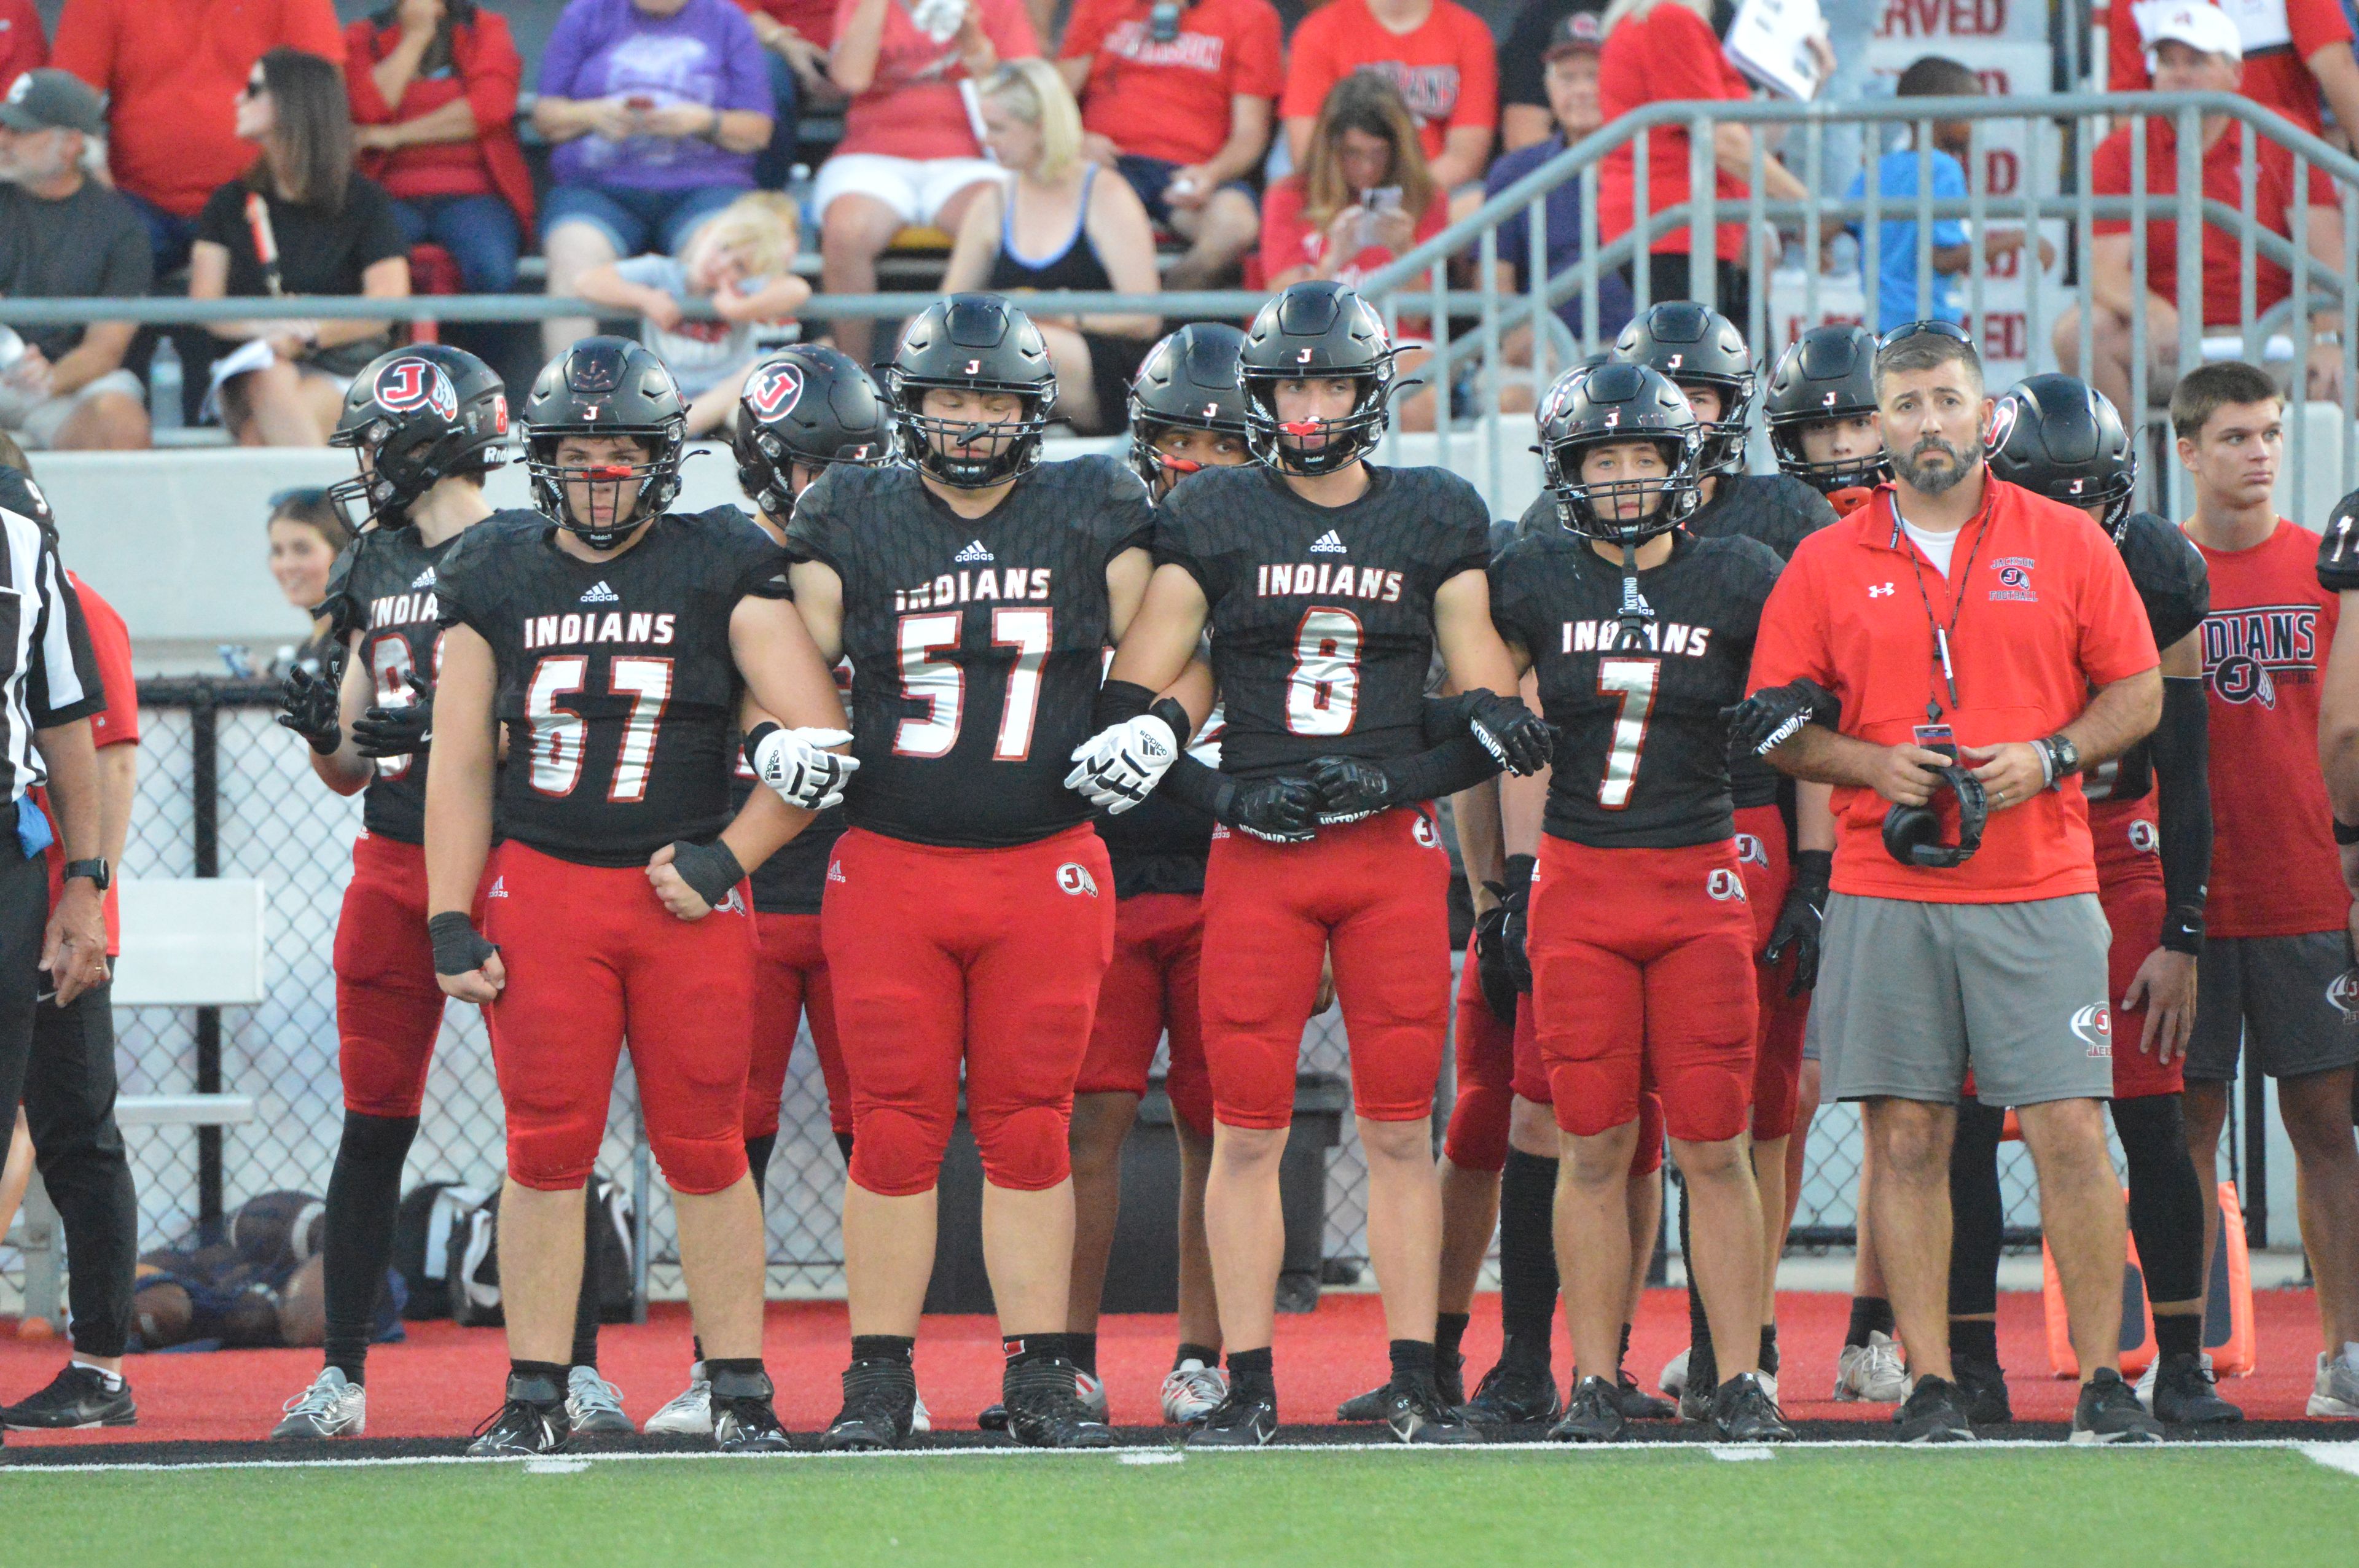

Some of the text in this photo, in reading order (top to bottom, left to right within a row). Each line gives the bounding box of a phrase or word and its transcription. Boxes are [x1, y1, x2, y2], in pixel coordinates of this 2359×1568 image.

[1297, 348, 1312, 363] J
[1668, 354, 1683, 369] J
[965, 360, 980, 374] J
[383, 363, 426, 403] J
[754, 372, 799, 413] J
[1823, 391, 1837, 406] J
[584, 406, 599, 421] J
[1202, 403, 1218, 418] J
[1605, 412, 1620, 427] J
[855, 445, 869, 459] J
[2070, 479, 2083, 494] J
[1310, 543, 1347, 553] adidas
[955, 552, 994, 563] adidas
[1990, 556, 2035, 569] JACKSON
[412, 577, 437, 588] adida
[894, 568, 1052, 611] INDIANS
[1258, 563, 1404, 603] INDIANS
[581, 593, 619, 603] adidas
[1624, 577, 1638, 610] NXTRND
[1990, 590, 2039, 602] FOOTBALL
[524, 612, 676, 649] INDIANS
[1285, 606, 1365, 738] 8
[2225, 663, 2251, 693] J
[891, 607, 1054, 762] 57
[524, 655, 675, 804] 67
[1597, 657, 1661, 811] 7
[1140, 730, 1167, 756] adidas
[765, 749, 779, 781] adidas
[1064, 867, 1081, 889] J
[1712, 872, 1729, 895] J
[2097, 1014, 2108, 1030] J
